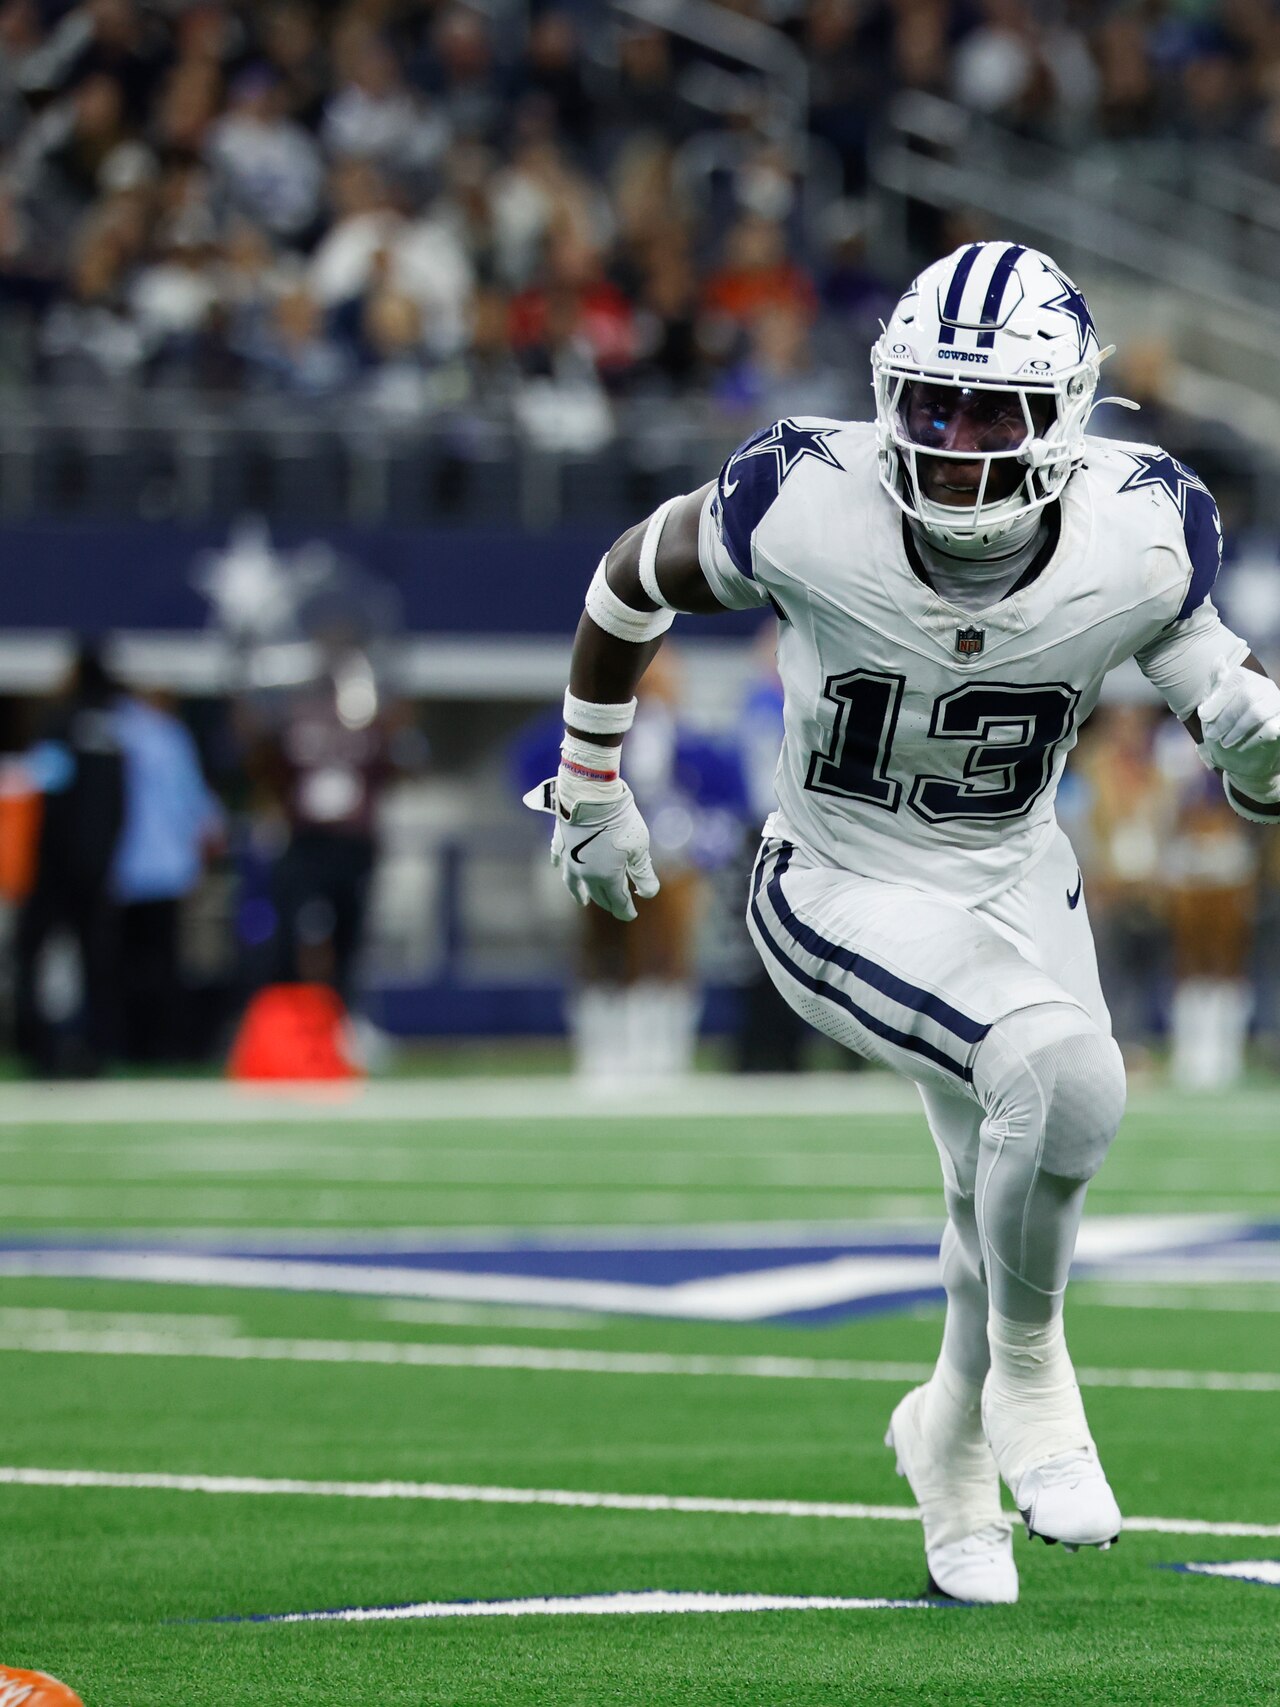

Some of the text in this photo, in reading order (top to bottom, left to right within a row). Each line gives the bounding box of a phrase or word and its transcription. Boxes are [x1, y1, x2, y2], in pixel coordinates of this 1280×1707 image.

[938, 349, 989, 364] COWBOYS
[1023, 368, 1055, 377] OAKLEY
[958, 639, 981, 652] NFL
[804, 668, 1082, 824] 13
